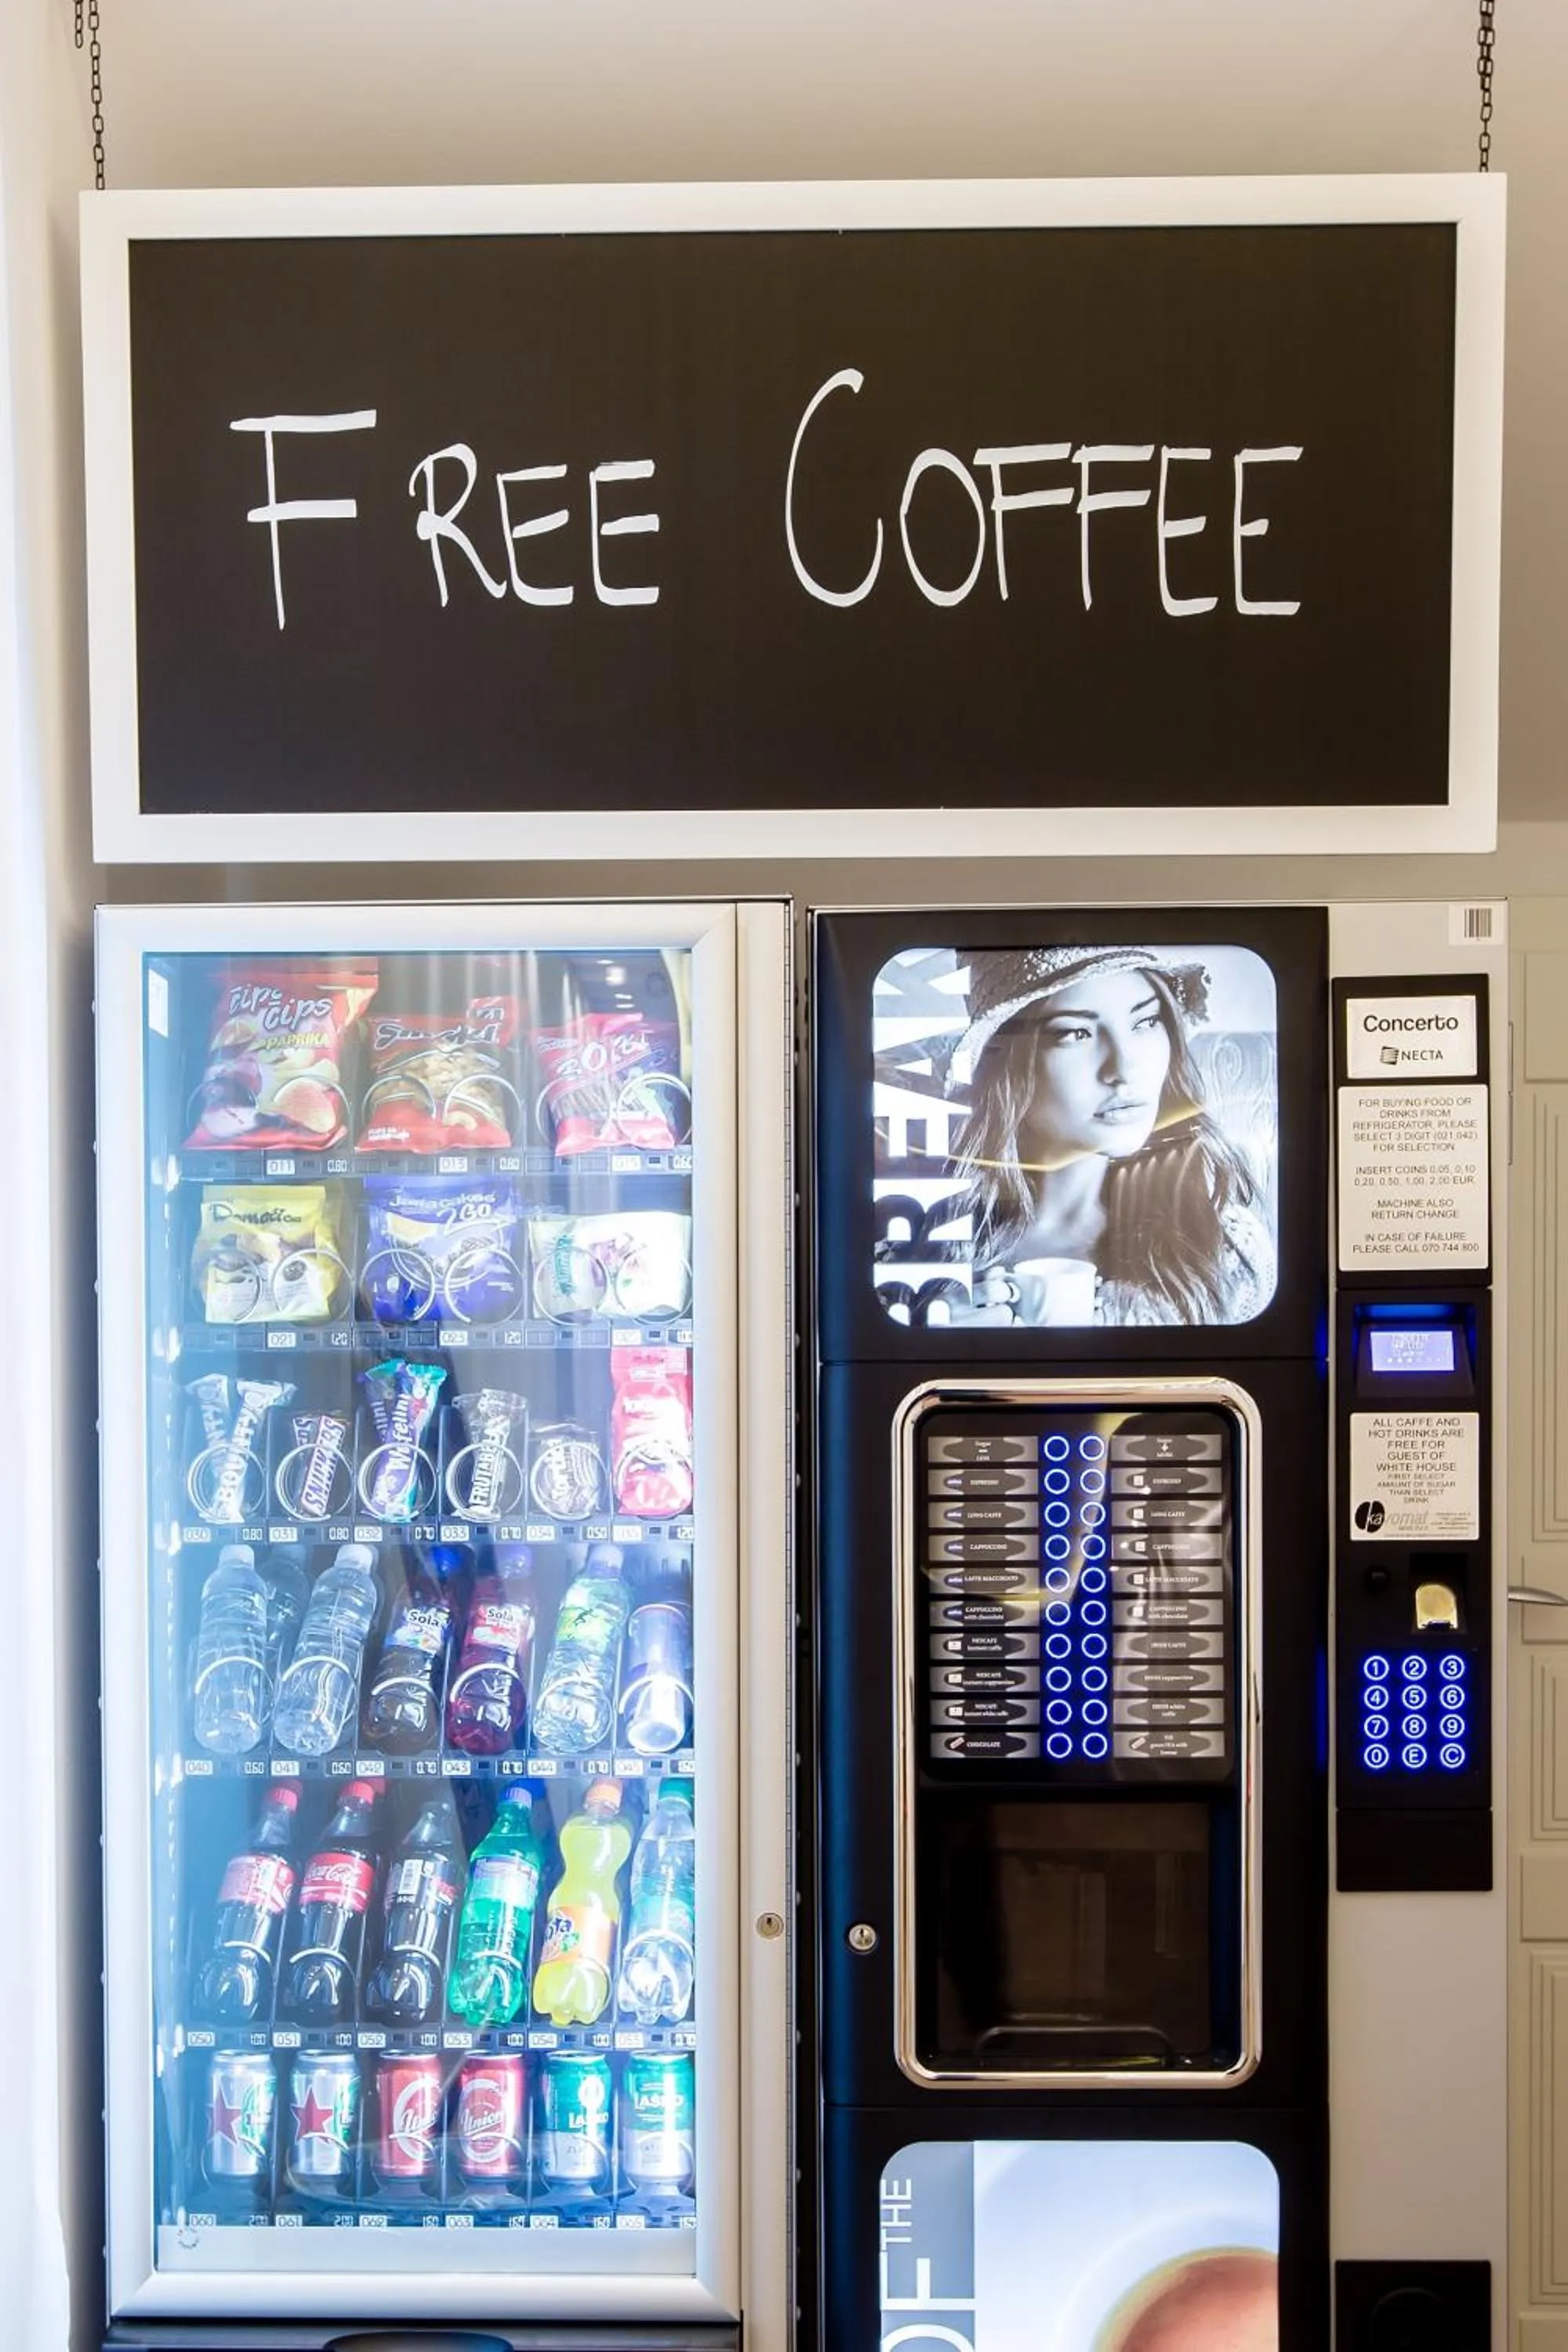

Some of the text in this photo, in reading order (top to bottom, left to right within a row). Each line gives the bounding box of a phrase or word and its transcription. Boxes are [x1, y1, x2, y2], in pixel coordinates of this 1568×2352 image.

[230, 368, 1304, 630] FREE COFFEE
[1363, 1014, 1458, 1032] Concerto
[267, 1033, 328, 1050] PAPRIKA
[1401, 1051, 1443, 1060] NECTA
[1383, 1098, 1421, 1107] BUYING
[1380, 1109, 1451, 1118] DRINKS FROM
[1439, 1120, 1477, 1128] PLEASE
[1355, 1132, 1394, 1141] SELECT
[1374, 1142, 1455, 1152] FOR SELECTION
[1356, 1166, 1392, 1174] INSERT
[1453, 1176, 1474, 1185] EUR
[1377, 1199, 1425, 1207] MACHINE
[1372, 1210, 1414, 1219] RETURN
[1407, 1232, 1421, 1241] OF
[1425, 1232, 1466, 1240] FAILURE
[1352, 1244, 1391, 1253] PLEASE
[1396, 1244, 1418, 1253] CALL
[1422, 1243, 1440, 1252] 070
[1373, 1417, 1460, 1427] ALL CAFFE AND
[1368, 1429, 1392, 1439] HOT
[1441, 1428, 1464, 1437] ARE
[1421, 1440, 1445, 1449] FOR
[1387, 1452, 1425, 1461] GUEST
[1376, 1463, 1412, 1472] WHITE
[408, 1610, 440, 1628] Sola
[488, 1608, 514, 1622] Sola
[1372, 1661, 1457, 1675] 1 2 3
[1371, 1691, 1457, 1704] 4 5 6
[1372, 1719, 1457, 1733] 7 8 9
[1372, 1748, 1458, 1762] 0 E C
[461, 2108, 503, 2134] Union
[880, 2179, 912, 2250] THE
